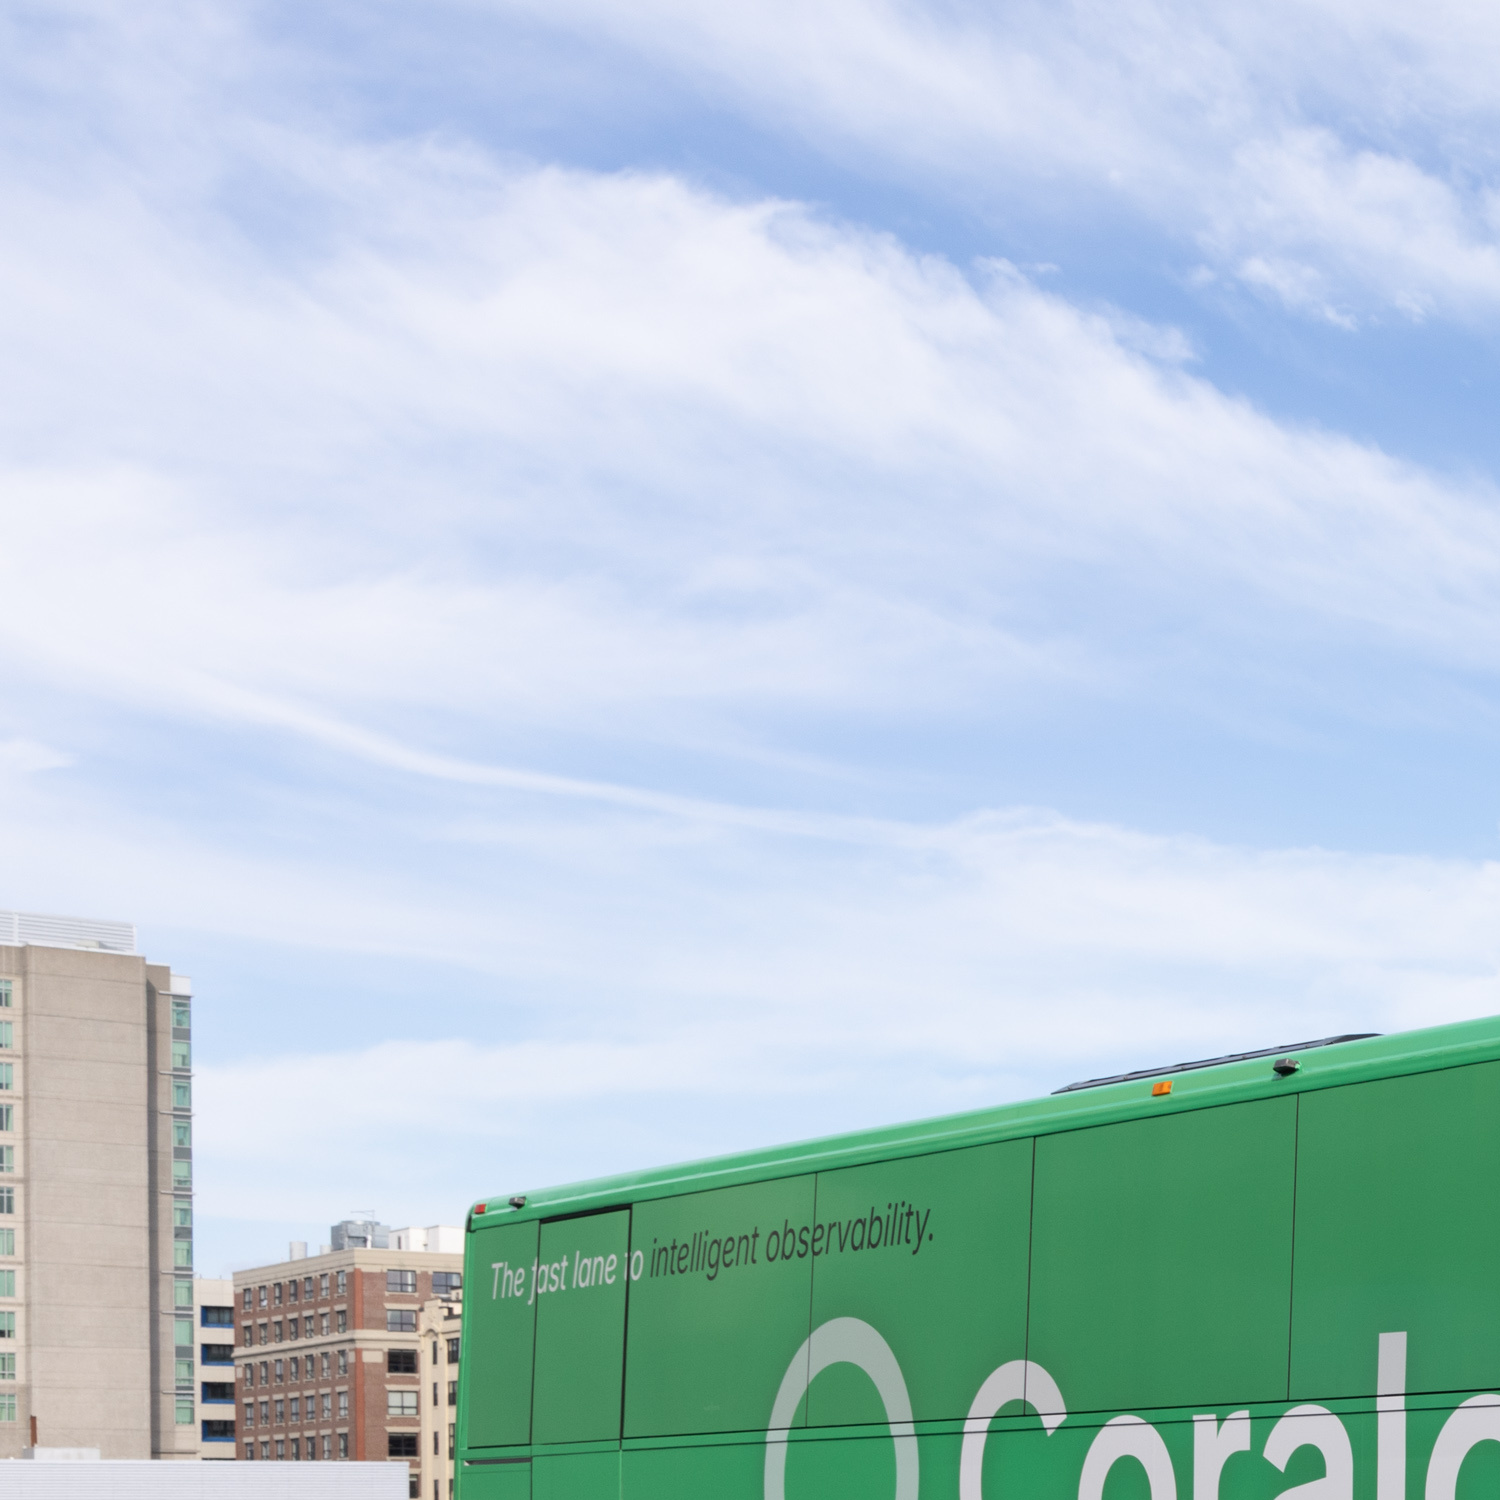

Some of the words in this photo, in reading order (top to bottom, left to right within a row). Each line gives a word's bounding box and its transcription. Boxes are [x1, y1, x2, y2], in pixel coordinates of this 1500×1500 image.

[491, 1261, 525, 1299] The
[527, 1255, 568, 1305] fast
[573, 1250, 617, 1288] lane
[650, 1226, 759, 1281] intelligent
[766, 1200, 934, 1262] observability.
